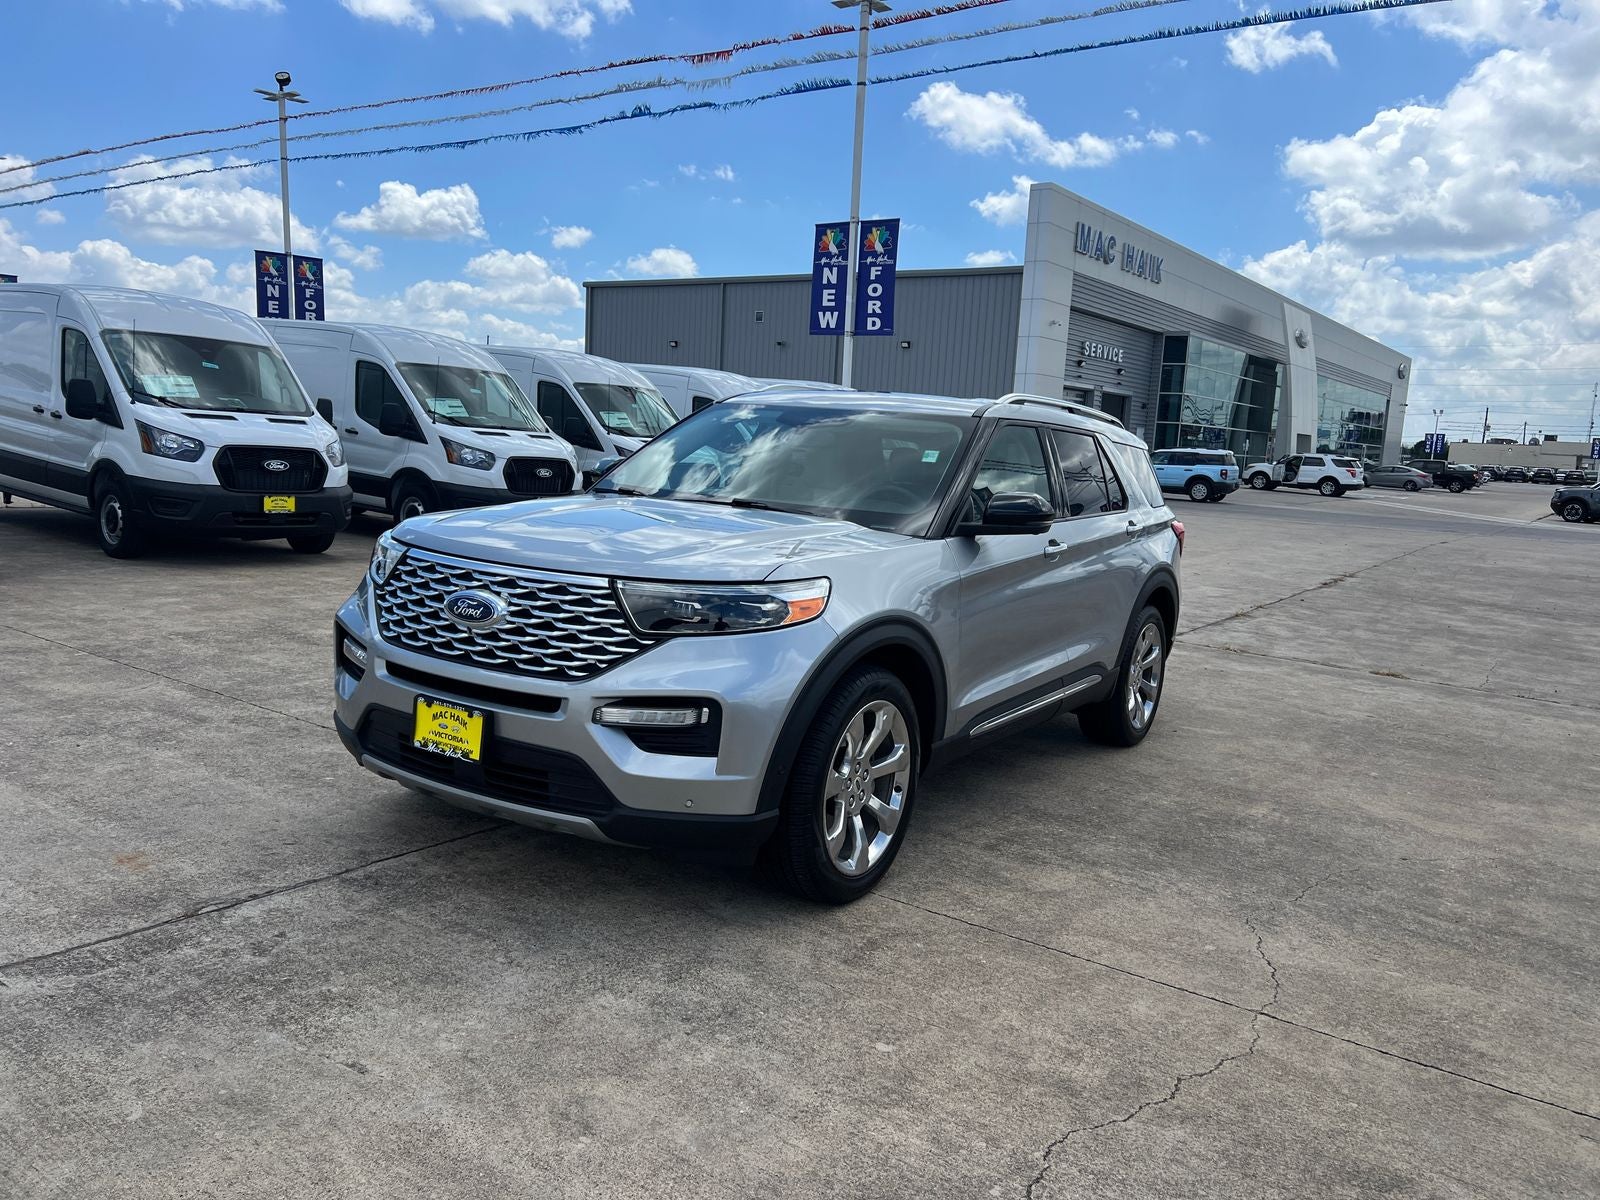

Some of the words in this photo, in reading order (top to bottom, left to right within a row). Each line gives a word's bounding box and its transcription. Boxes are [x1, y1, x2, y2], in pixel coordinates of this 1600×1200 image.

[1075, 221, 1117, 265] MAC
[1121, 242, 1164, 285] HAIK
[266, 284, 283, 319] NE
[818, 267, 839, 329] NEW
[866, 266, 883, 331] FORD
[1084, 341, 1124, 363] SERVICE
[454, 599, 483, 618] Ford
[432, 710, 448, 721] MAC
[449, 711, 468, 730] HAIK
